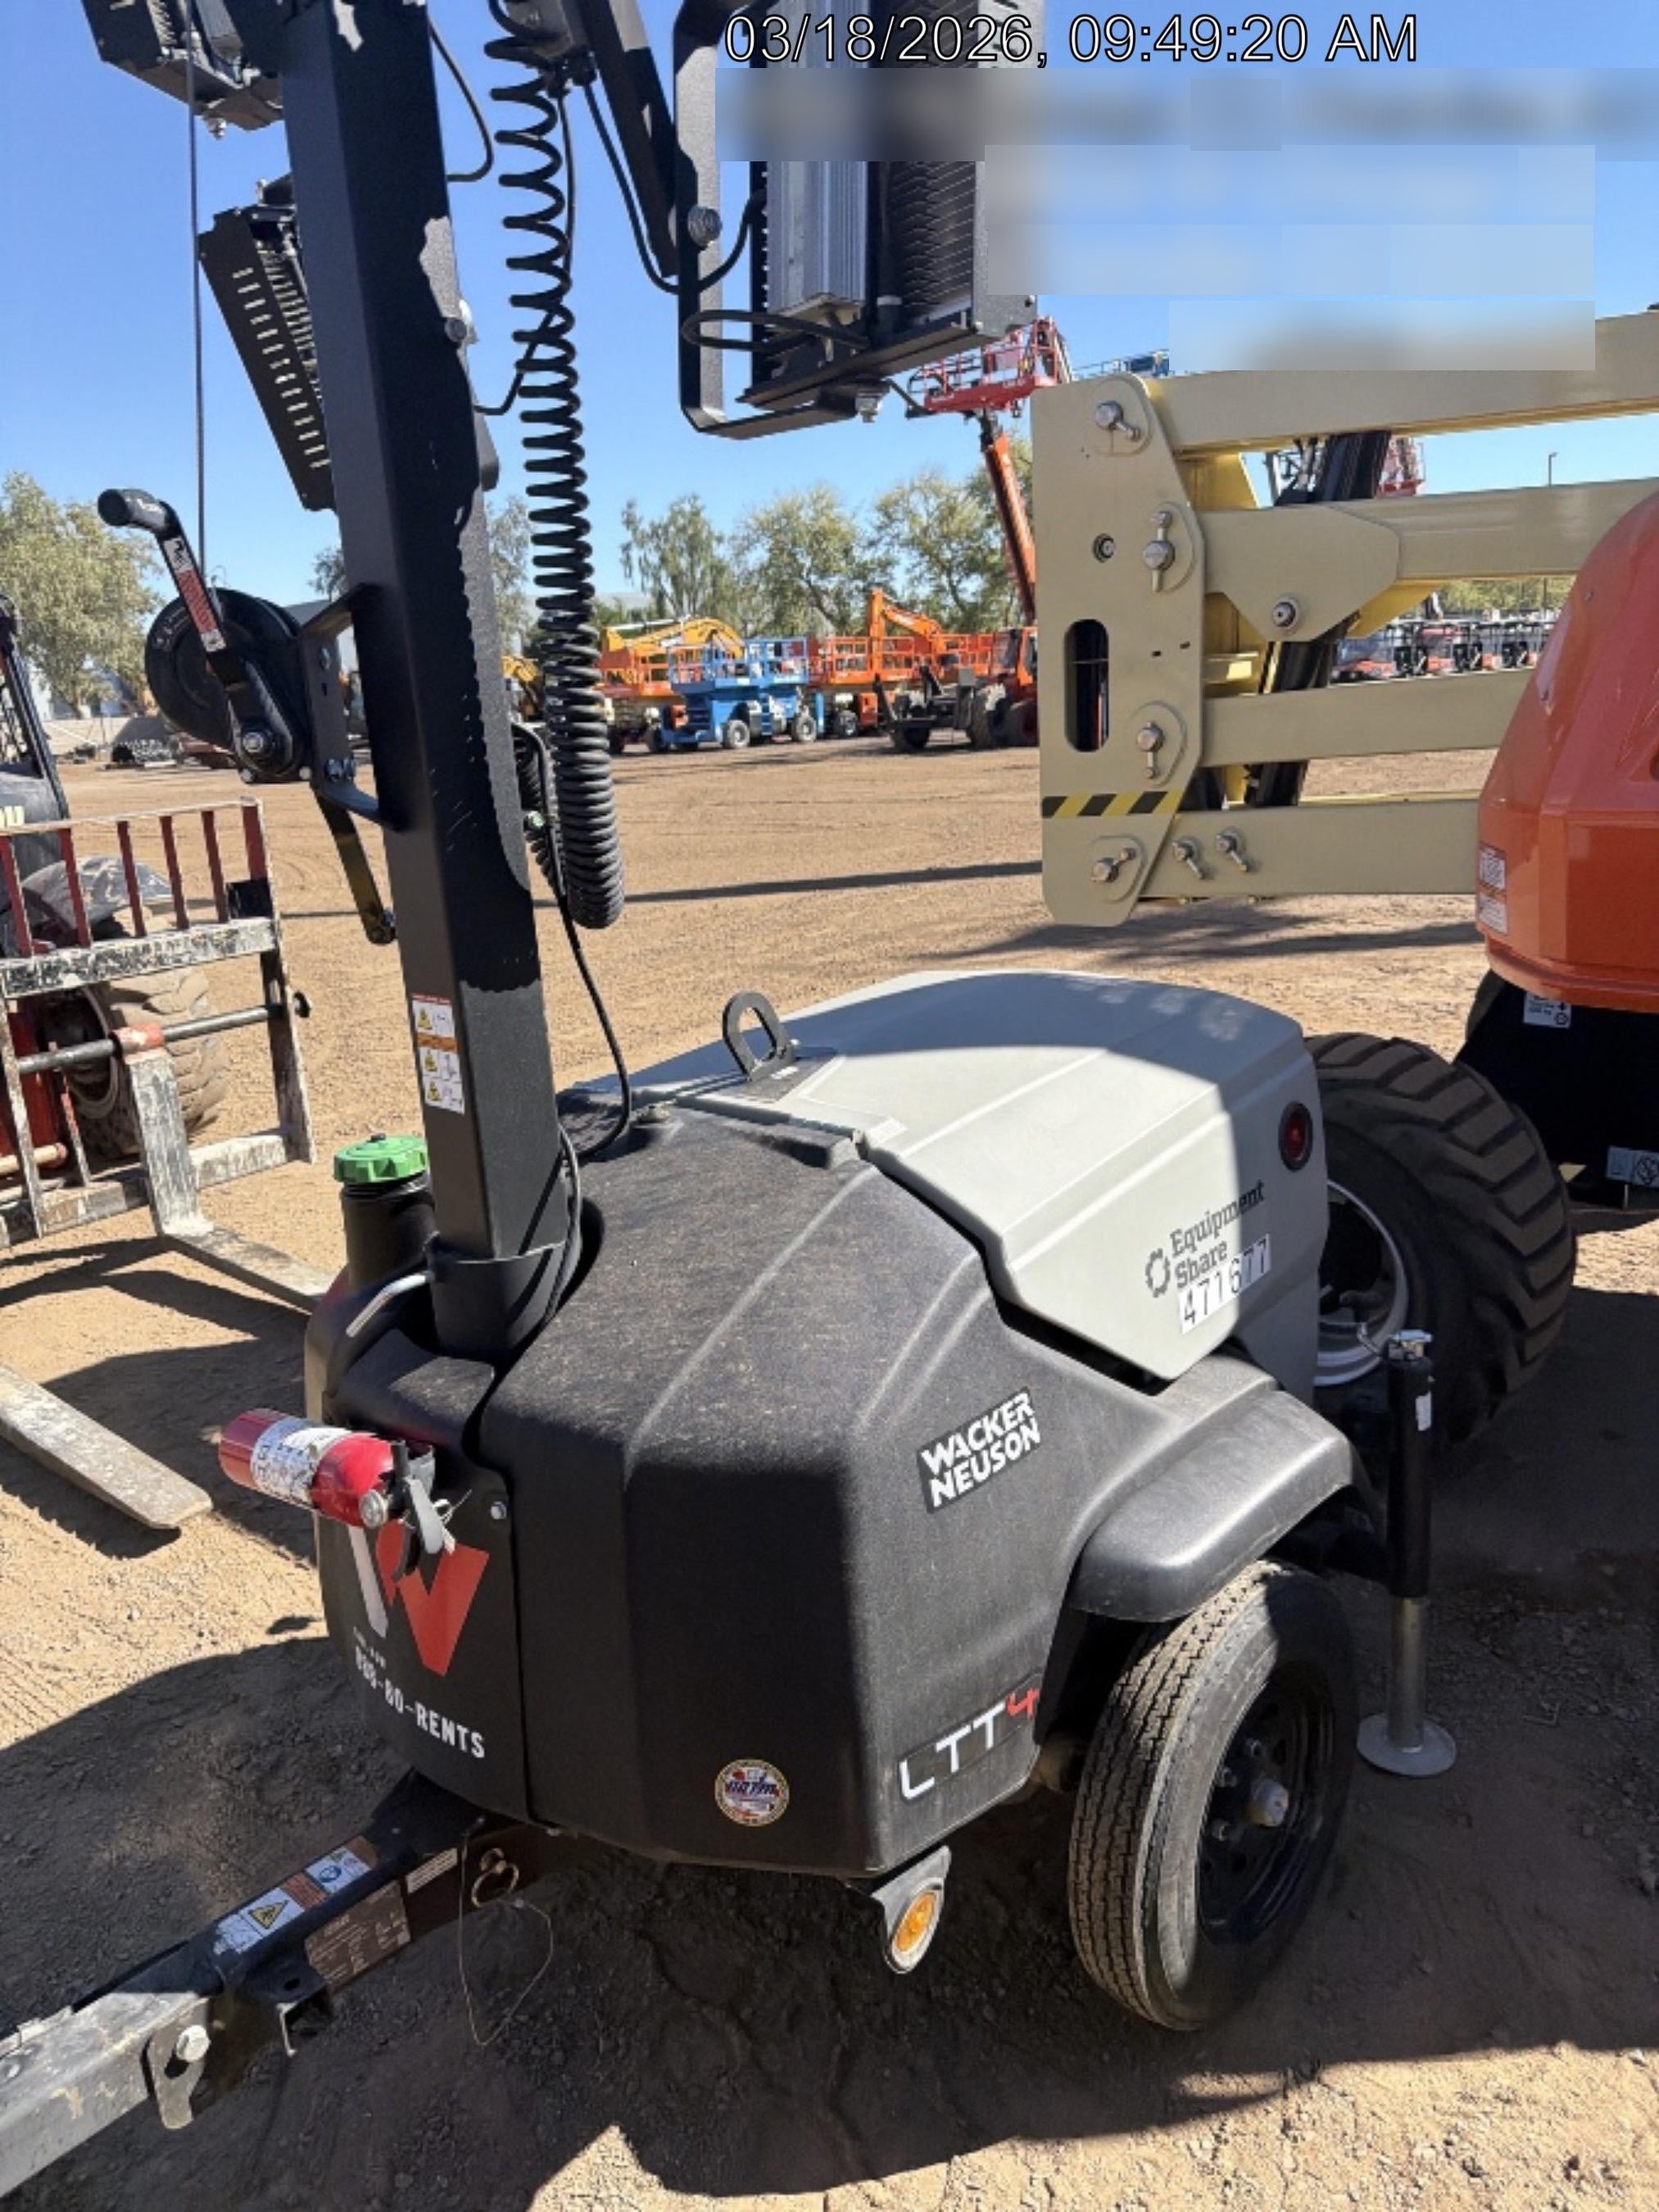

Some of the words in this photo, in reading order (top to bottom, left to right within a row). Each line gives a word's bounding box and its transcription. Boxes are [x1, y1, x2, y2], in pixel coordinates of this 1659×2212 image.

[1170, 1179, 1264, 1258] Equipment
[1175, 1240, 1227, 1289] Share
[1184, 1238, 1267, 1325] 471677
[920, 1392, 1036, 1475] WACKER
[929, 1416, 1040, 1507] NEUSON
